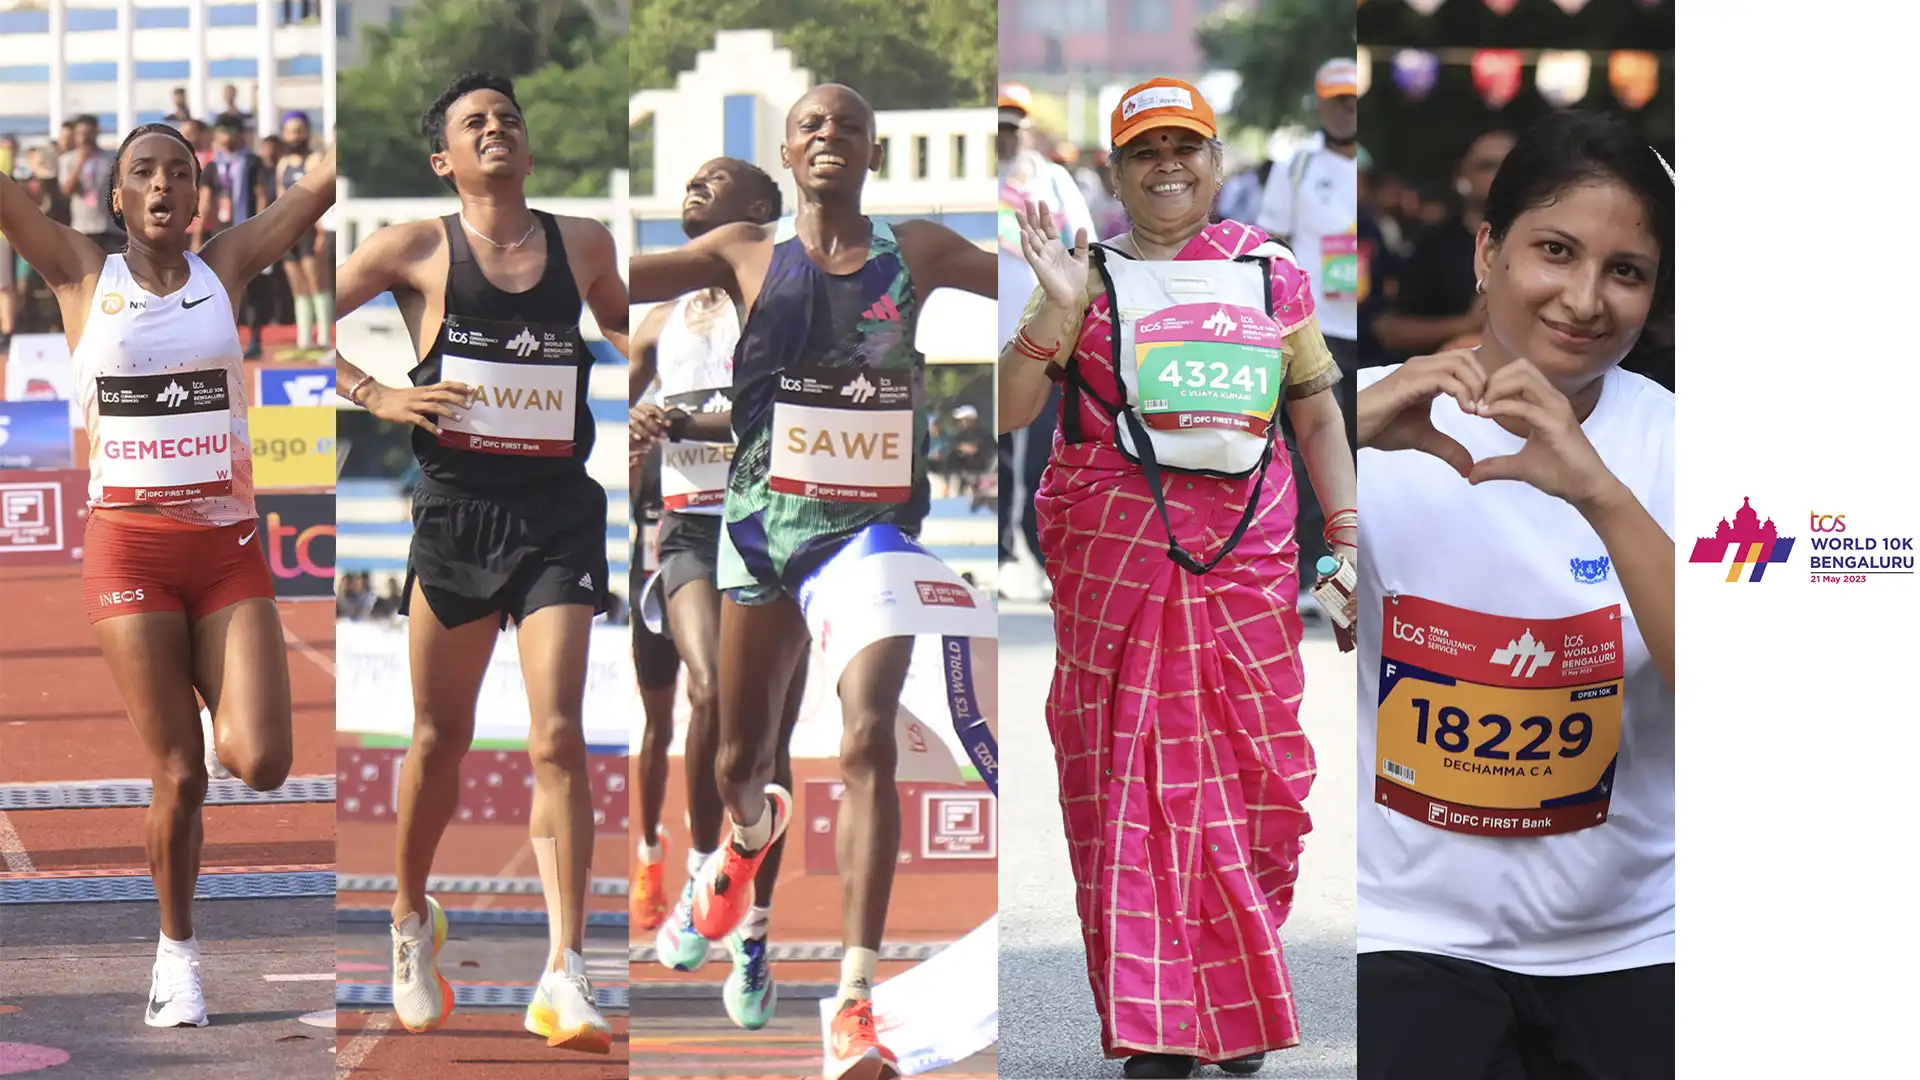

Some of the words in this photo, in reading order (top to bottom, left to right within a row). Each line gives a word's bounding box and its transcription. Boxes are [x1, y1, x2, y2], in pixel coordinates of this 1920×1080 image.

[448, 327, 469, 344] tcs
[544, 332, 555, 341] tcs
[1140, 322, 1161, 334] tcs
[192, 381, 205, 389] tcs
[781, 376, 802, 391] tcs
[1158, 360, 1267, 396] 43241
[101, 389, 120, 403] tcs
[1189, 391, 1219, 400] VIJAYA
[1221, 393, 1252, 401] KUMARI
[1193, 416, 1211, 424] IDFC
[1213, 417, 1233, 425] FIRST
[1234, 419, 1251, 427] Bank
[104, 434, 228, 460] GEMECHU
[483, 440, 499, 448] IDFC
[501, 442, 521, 450] FIRST
[788, 426, 900, 460] SAWE
[216, 470, 228, 480] W
[100, 588, 145, 607] INEOS
[1393, 615, 1425, 645] tcs
[1429, 625, 1449, 637] TATA
[1428, 634, 1477, 652] CONSULTANCY
[1428, 641, 1458, 656] SERVICES
[1563, 645, 1599, 658] WORLD
[1600, 640, 1615, 651] 10K
[1564, 634, 1584, 648] tcs
[948, 640, 966, 693] WORLD
[1562, 651, 1616, 669] BENGALURU
[1386, 664, 1397, 678] F
[1577, 690, 1597, 699] OPEN
[1599, 687, 1611, 696] 10K
[956, 697, 972, 719] TCS
[1412, 698, 1593, 761] 18229
[973, 741, 998, 774] 2023
[1443, 758, 1525, 776] DECHAMMA
[1530, 767, 1539, 776] C
[1543, 766, 1553, 776] A
[1450, 812, 1479, 827] IDFC
[1482, 817, 1519, 829] FIRST
[1522, 815, 1551, 829] Bank
